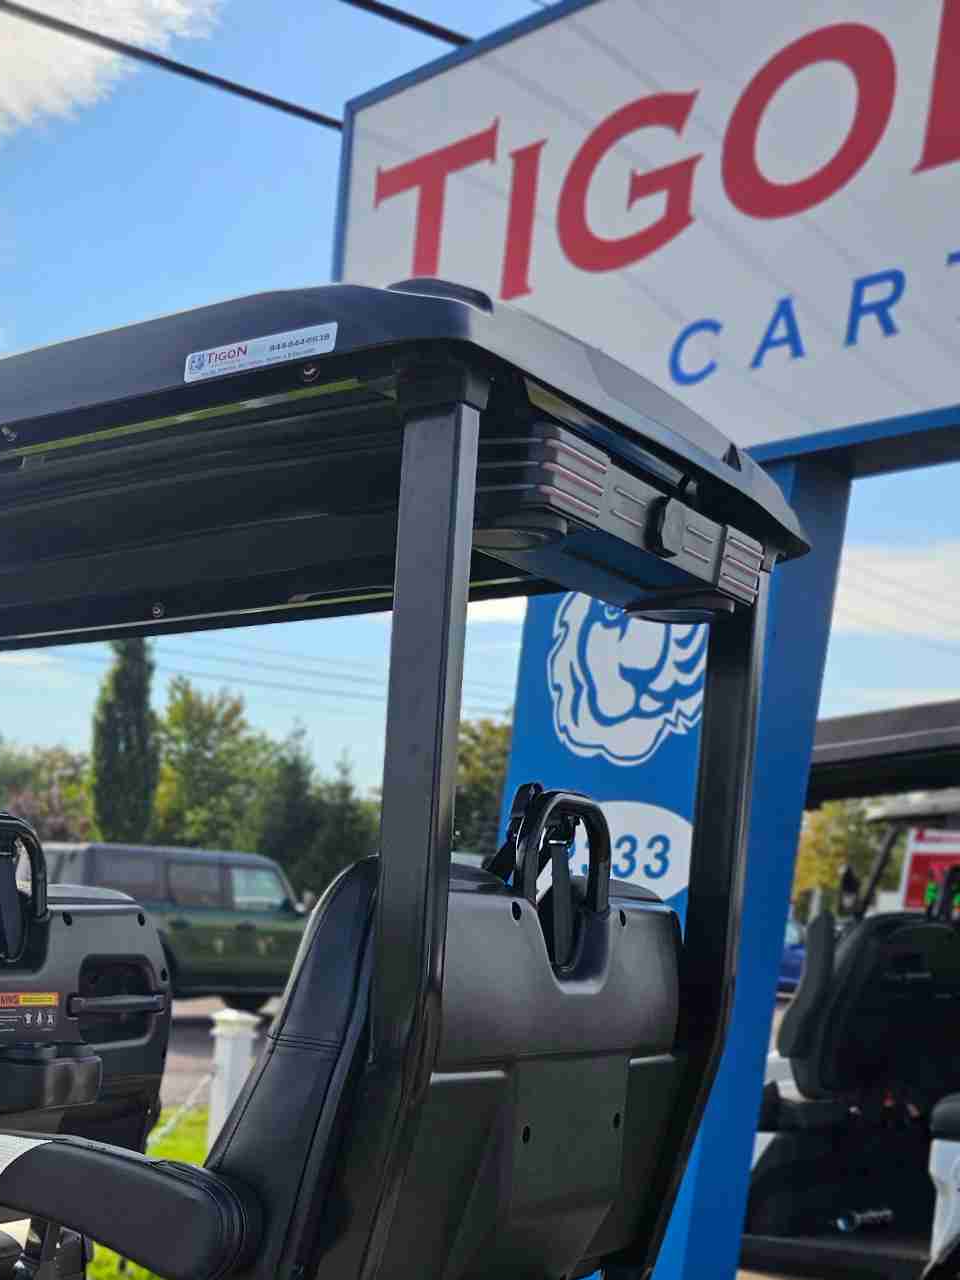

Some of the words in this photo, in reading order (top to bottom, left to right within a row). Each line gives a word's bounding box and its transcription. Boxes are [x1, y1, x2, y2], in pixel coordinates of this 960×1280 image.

[373, 0, 960, 301] TIGO
[208, 344, 248, 363] TIGON
[668, 250, 960, 386] CAR
